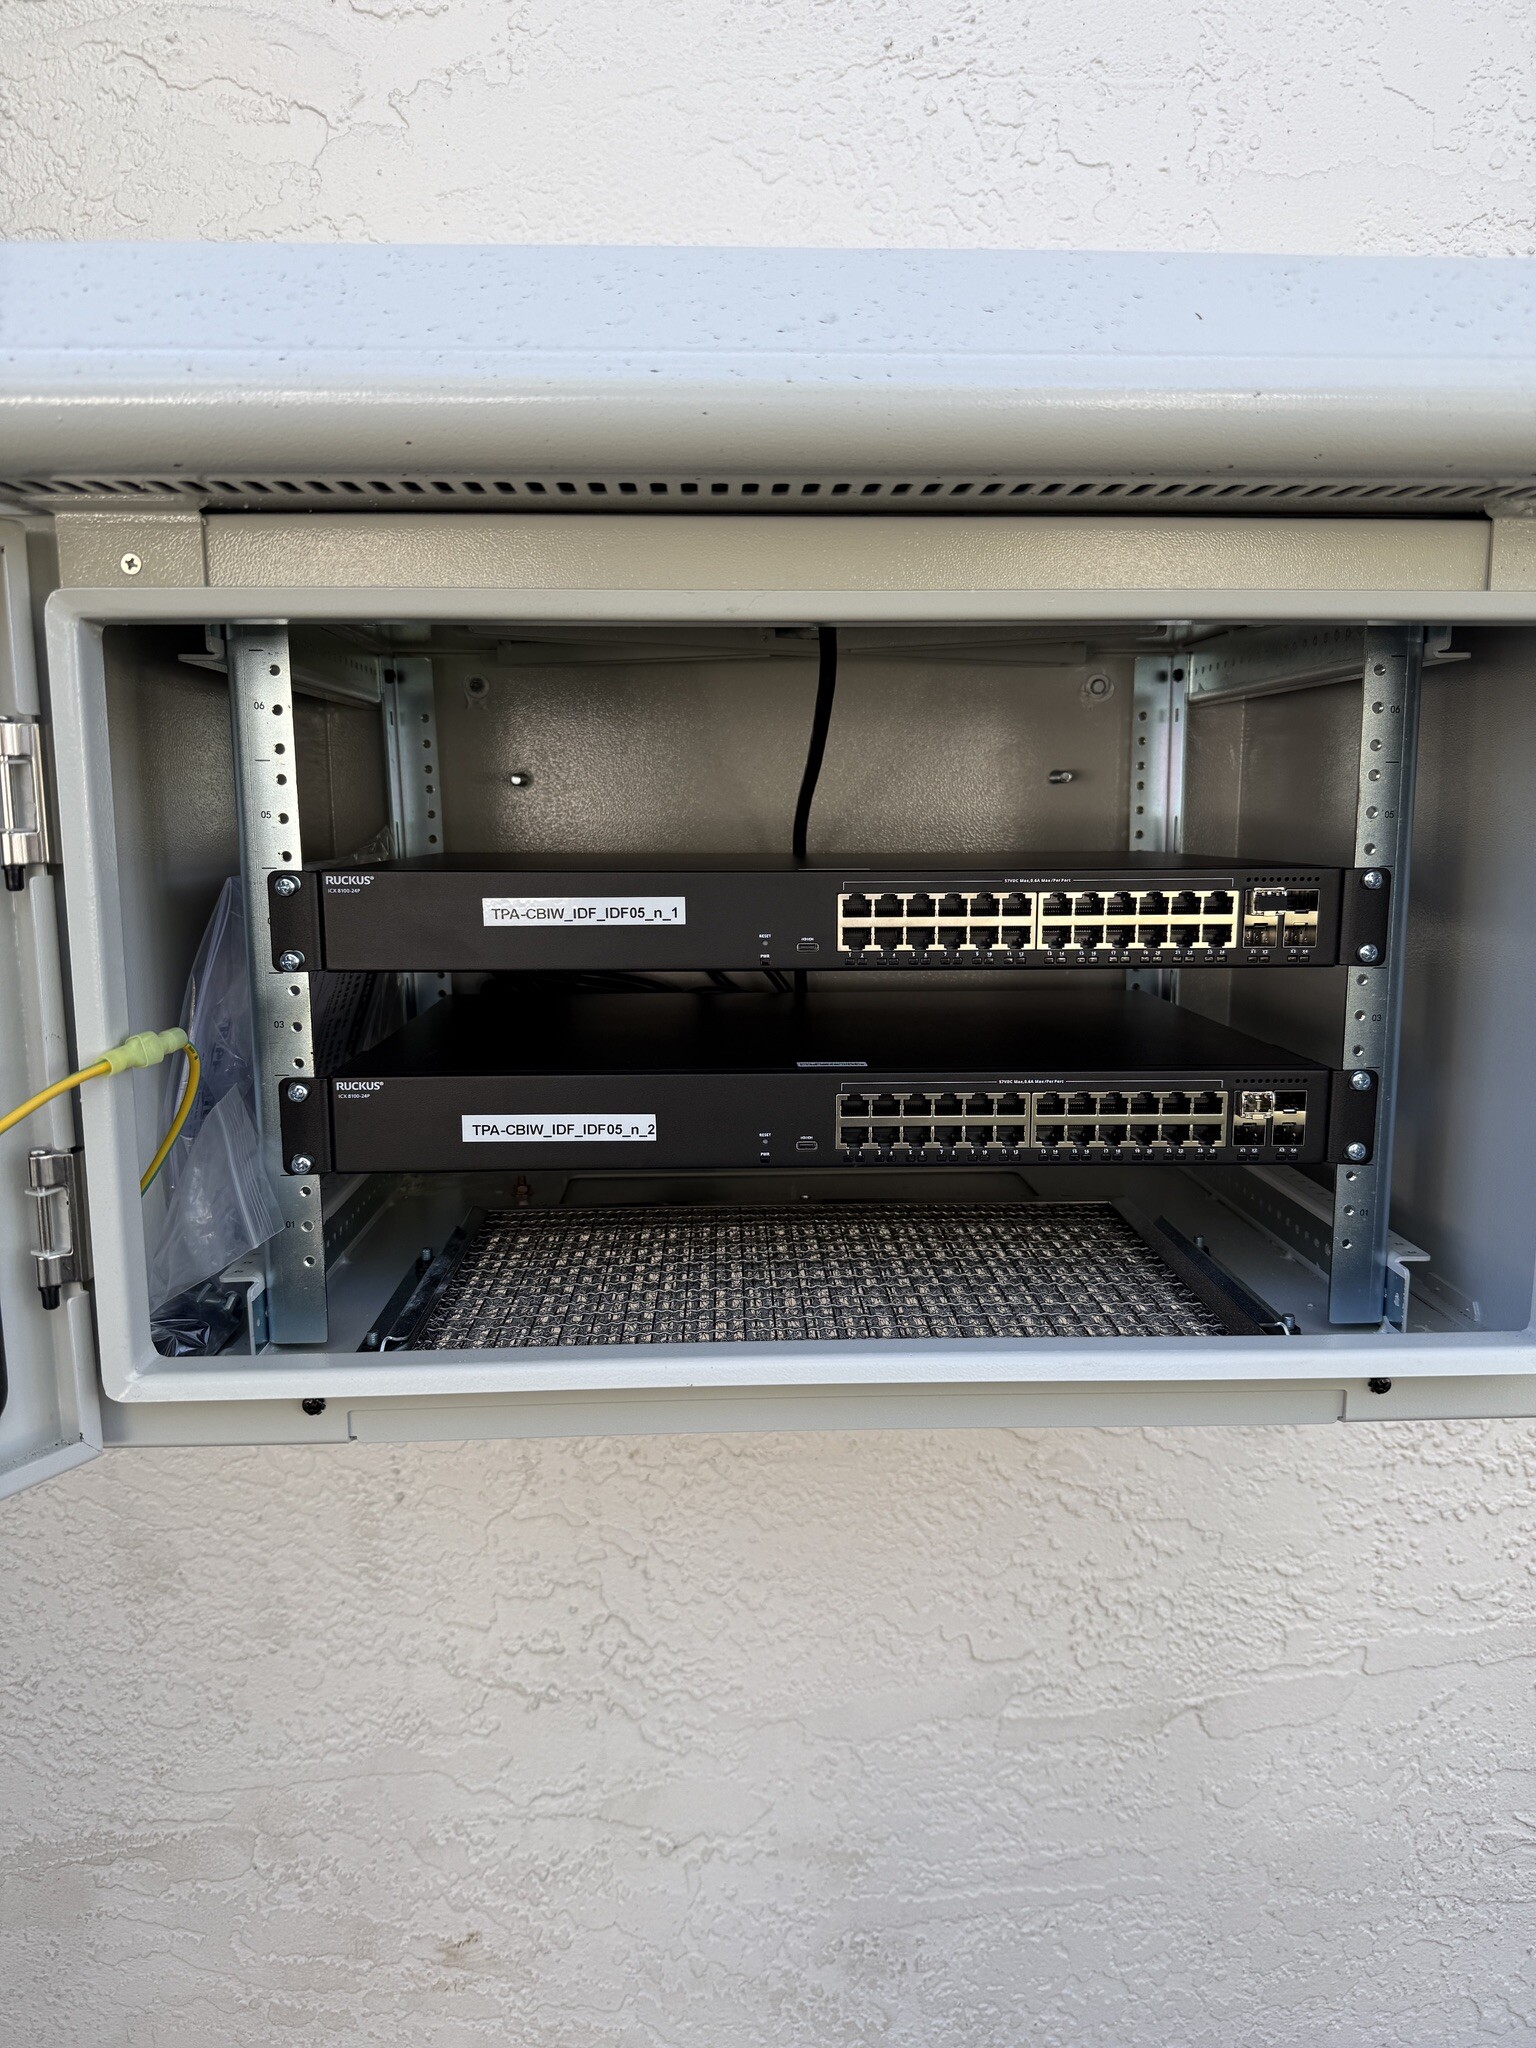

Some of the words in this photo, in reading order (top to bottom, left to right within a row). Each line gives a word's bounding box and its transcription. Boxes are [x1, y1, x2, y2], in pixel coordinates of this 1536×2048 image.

[254, 701, 264, 710] 06
[1390, 705, 1400, 714] 06
[261, 810, 271, 819] 05
[1384, 810, 1394, 819] 05
[491, 907, 679, 922] TPA-CBIW_IDF_IDF05_n_1
[1371, 1014, 1382, 1022] 03
[274, 1020, 285, 1029] 03
[472, 1123, 656, 1138] TPA-CBIW_IDF_IDF05_n_2
[1360, 1209, 1369, 1217] 01
[285, 1220, 295, 1229] 01
